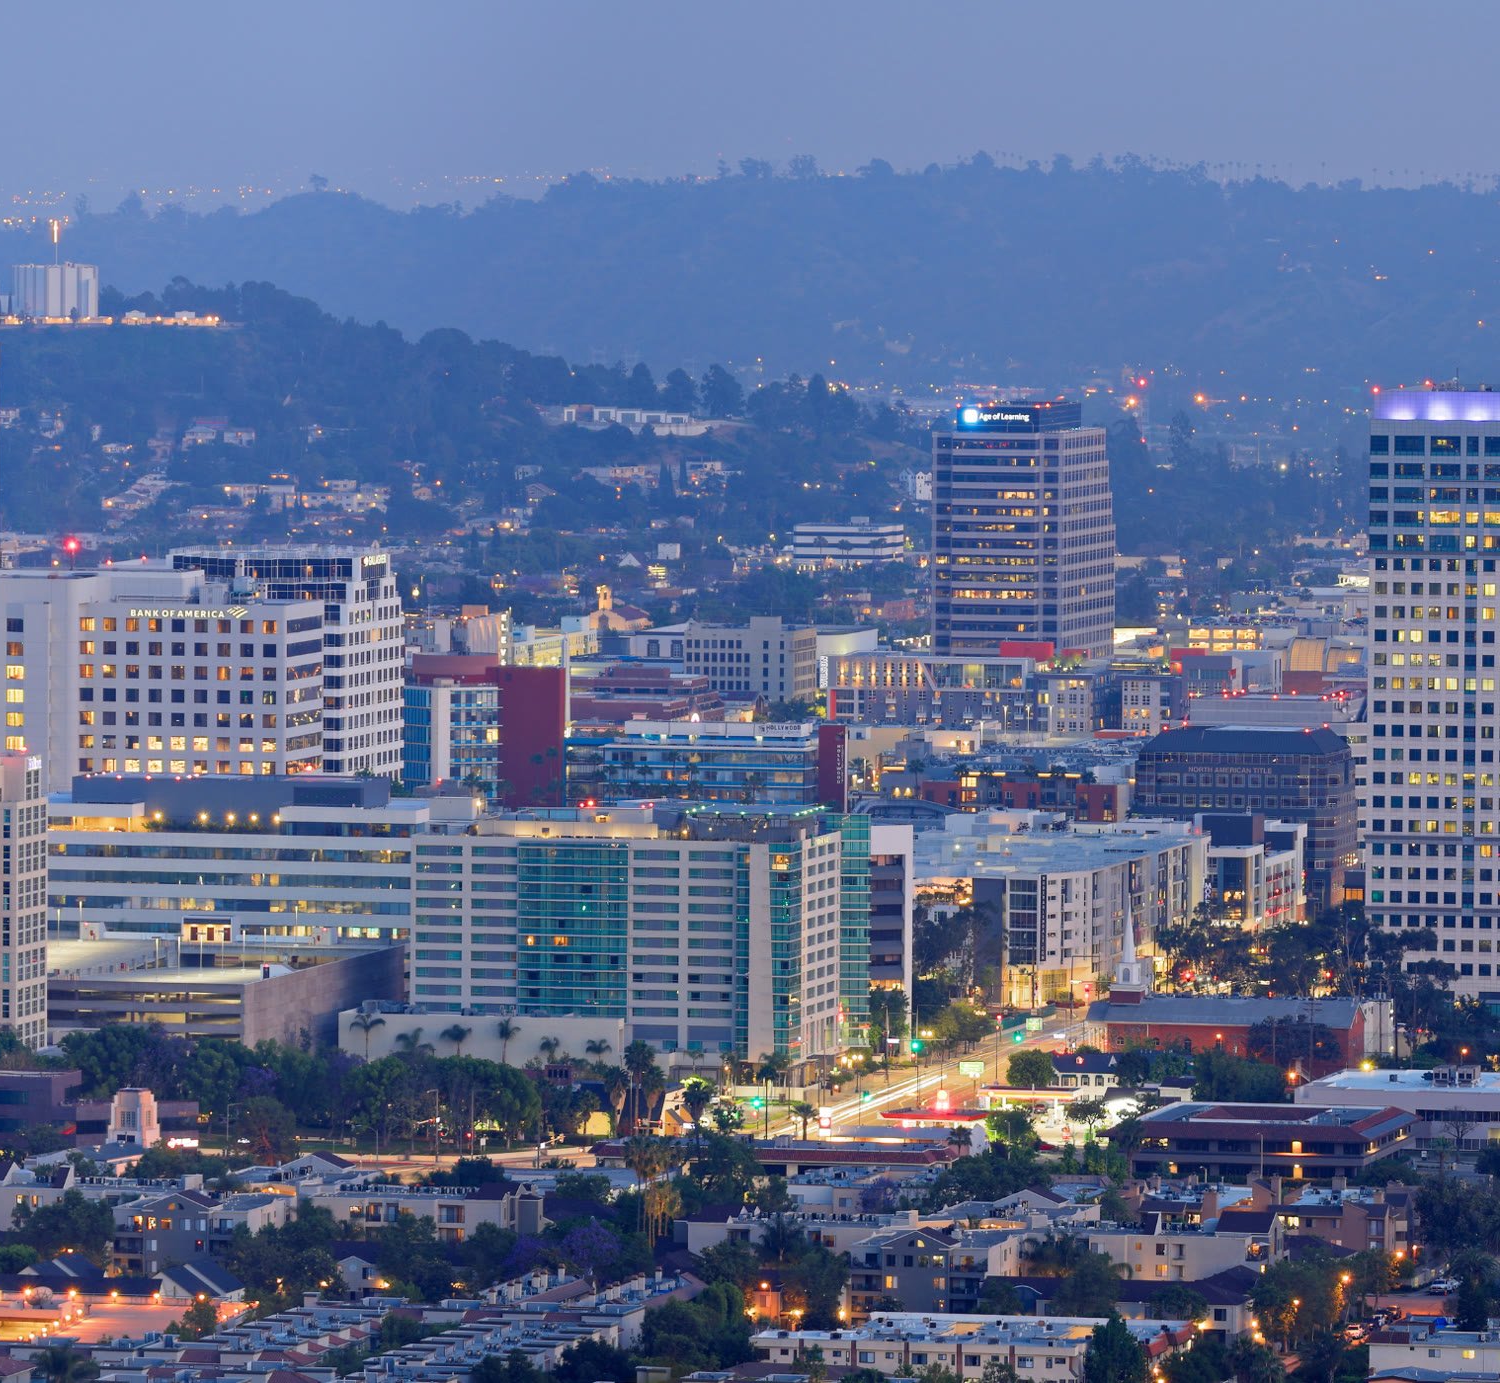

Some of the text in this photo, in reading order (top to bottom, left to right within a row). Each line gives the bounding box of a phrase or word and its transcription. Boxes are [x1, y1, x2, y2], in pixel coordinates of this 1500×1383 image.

[979, 413, 992, 421] Age
[1001, 413, 1030, 422] Learning
[130, 609, 225, 618] BANK OF AMERICA
